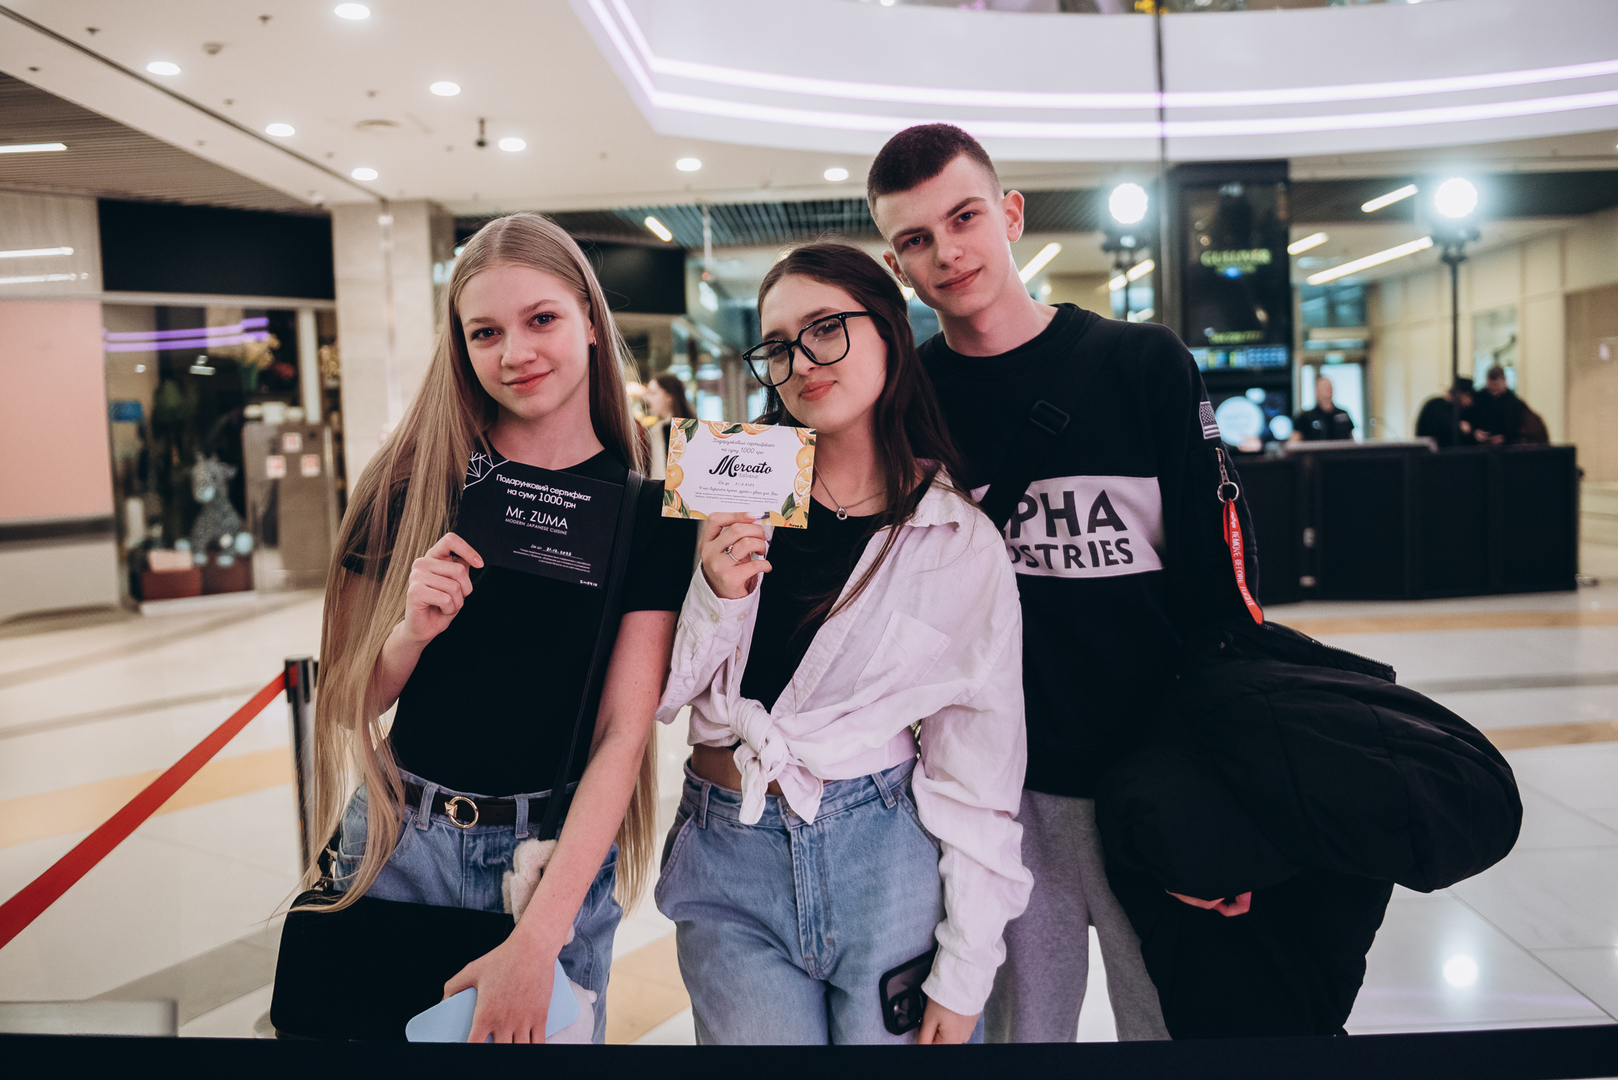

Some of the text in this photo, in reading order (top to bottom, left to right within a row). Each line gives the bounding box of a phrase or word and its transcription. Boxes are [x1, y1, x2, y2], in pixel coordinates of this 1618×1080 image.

[709, 455, 772, 477] Mercato
[496, 474, 592, 502] Подарунковий сертифікат
[518, 490, 537, 500] суму
[538, 492, 563, 506] 1000
[564, 500, 576, 509] грн
[505, 506, 568, 529] Mr. ZUMA
[505, 518, 525, 526] MODERN
[526, 523, 549, 532] JAPANESE
[1001, 490, 1128, 539] PHA
[1232, 531, 1241, 557] REMOVE
[1235, 559, 1244, 583] BEFORE
